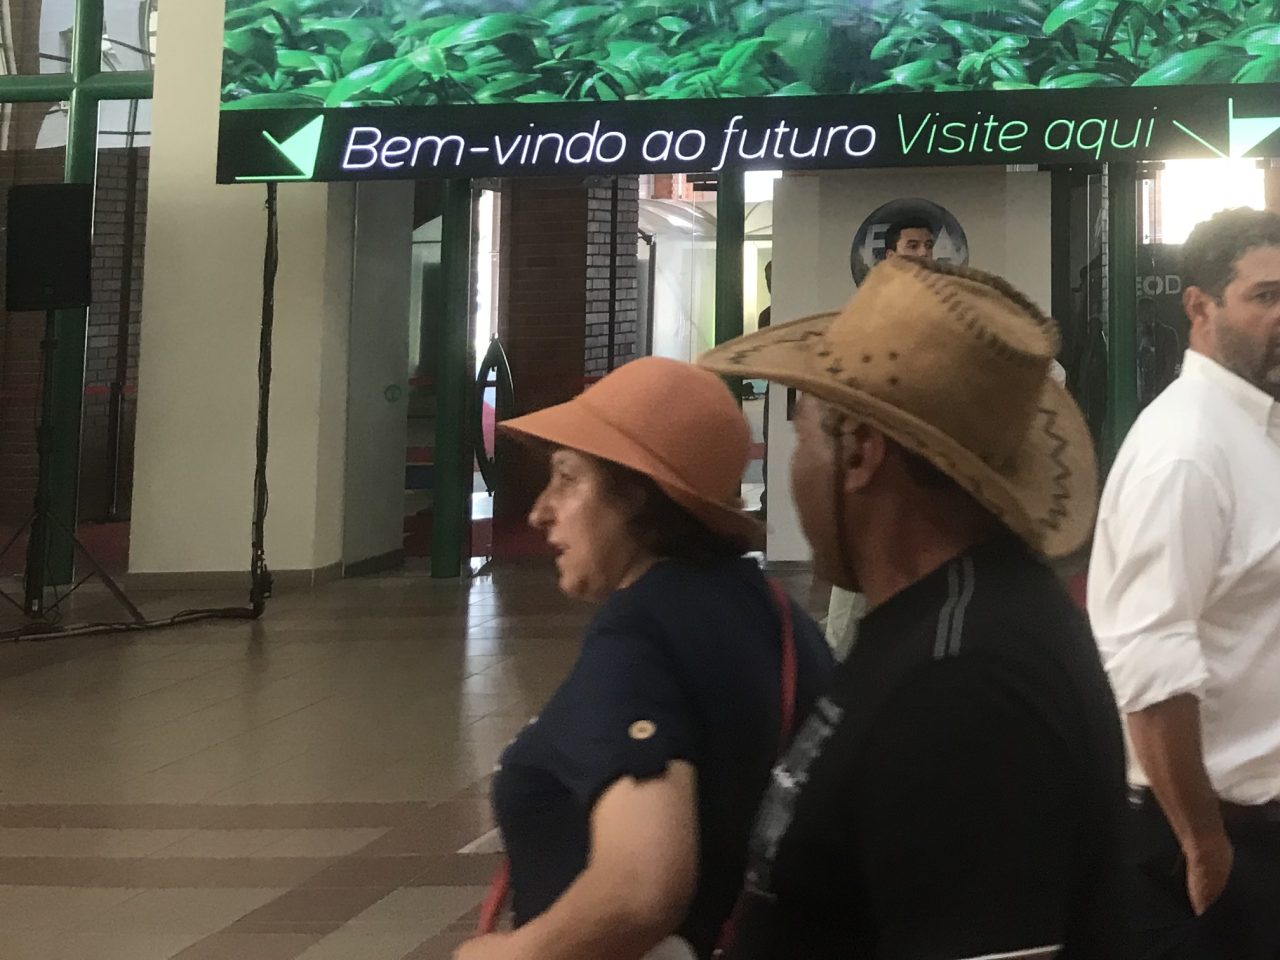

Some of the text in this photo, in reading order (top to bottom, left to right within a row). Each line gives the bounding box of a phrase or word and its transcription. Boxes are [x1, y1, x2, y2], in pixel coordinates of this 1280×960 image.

[341, 115, 877, 171] Bem-vindo ao futuro
[896, 105, 1159, 160] Visite aqui
